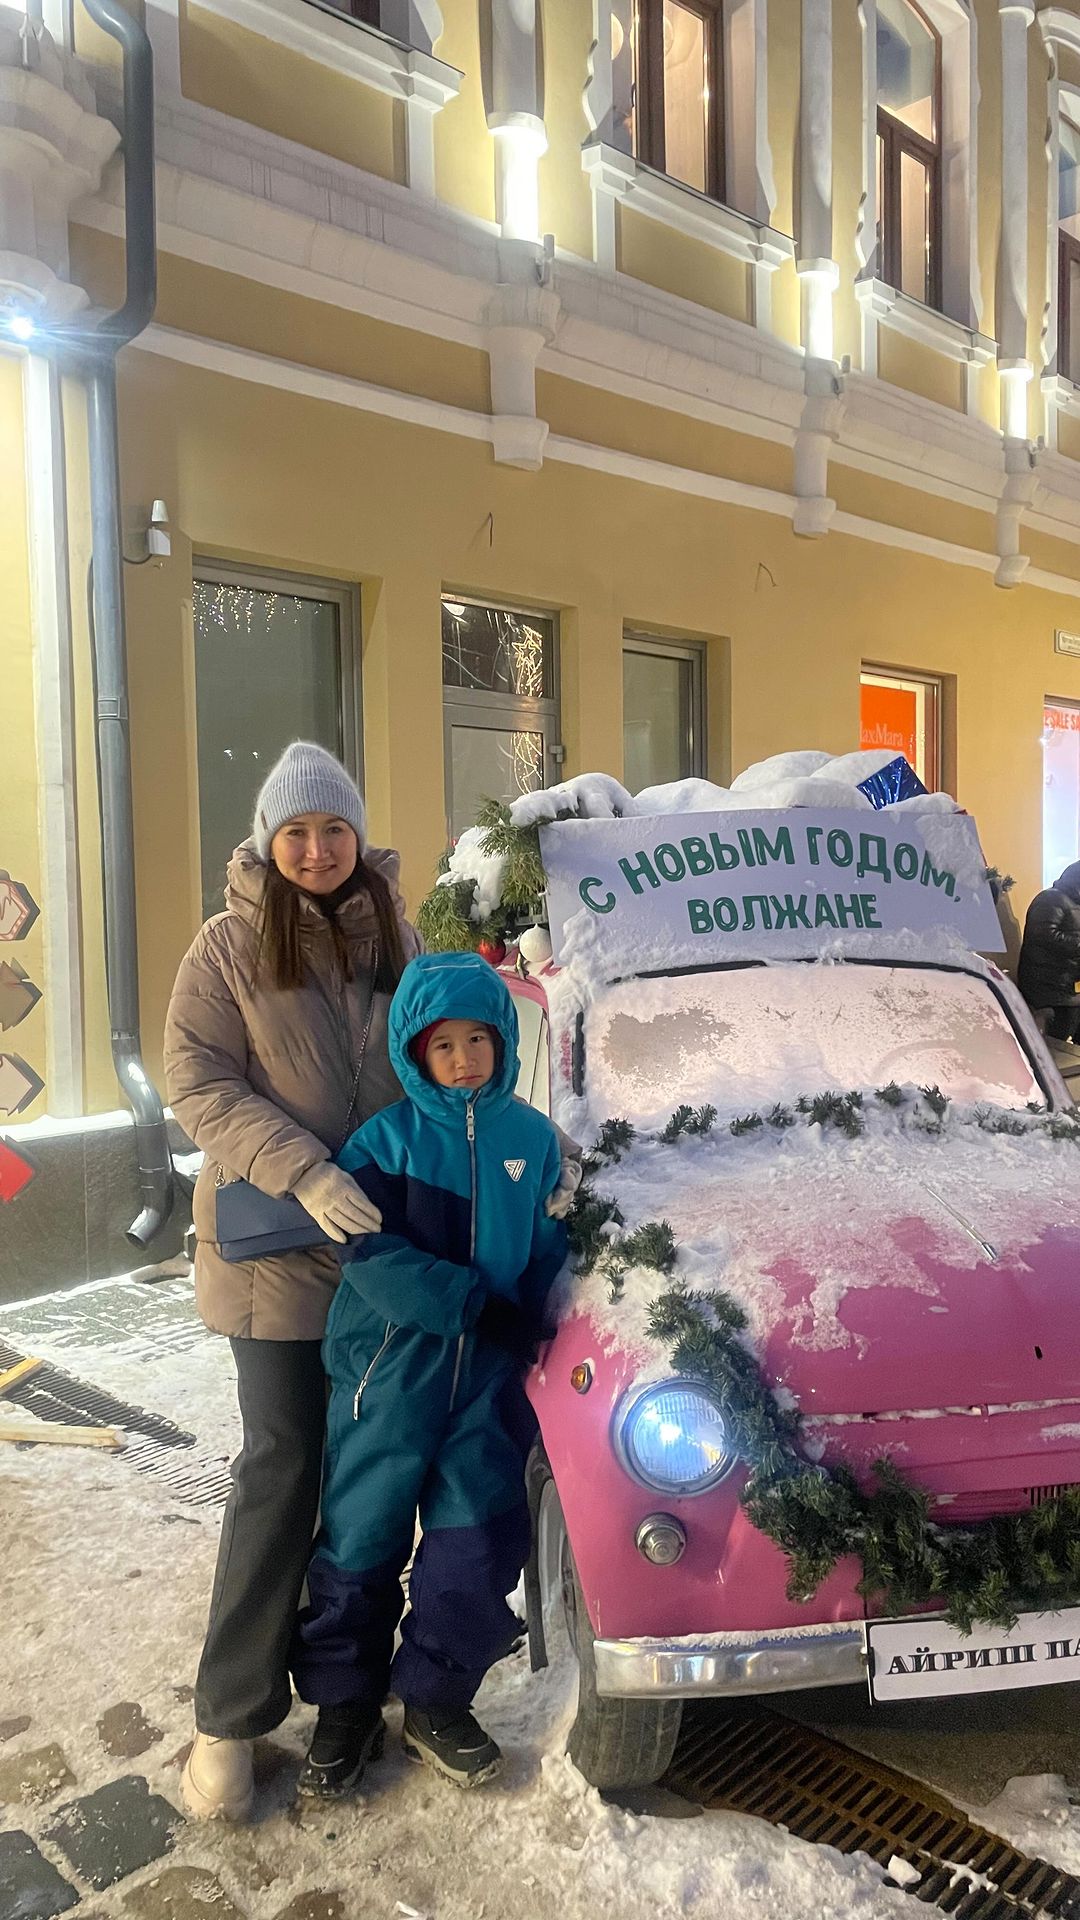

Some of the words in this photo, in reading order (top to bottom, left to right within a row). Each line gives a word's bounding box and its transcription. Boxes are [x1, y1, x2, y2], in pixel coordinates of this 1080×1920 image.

[860, 720, 904, 747] axMara
[578, 876, 617, 914] С
[617, 826, 796, 895] НОВЫМ
[687, 894, 883, 935] ВОЛЖАНЕ
[885, 1643, 1038, 1676] АЙРИШ
